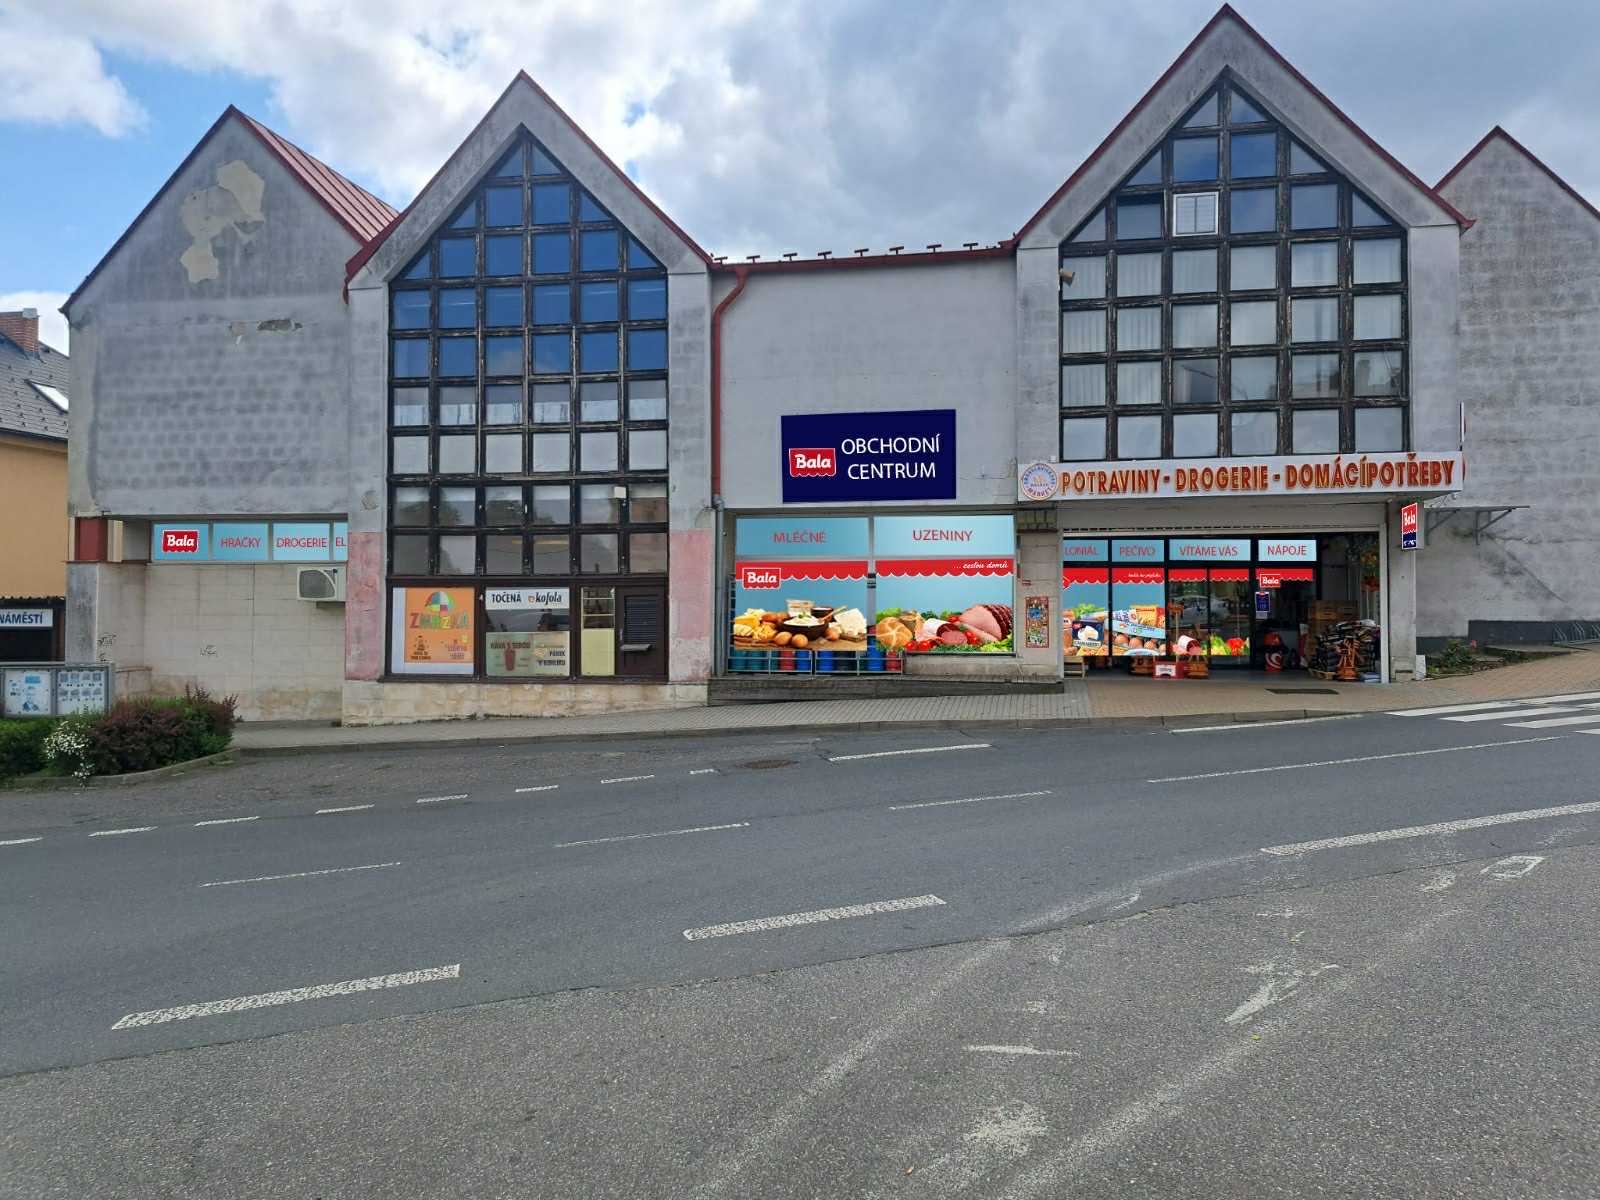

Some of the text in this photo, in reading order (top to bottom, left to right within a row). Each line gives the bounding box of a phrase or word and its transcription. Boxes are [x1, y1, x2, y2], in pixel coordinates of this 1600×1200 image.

[841, 433, 940, 455] OBCHODNÍ
[794, 453, 832, 469] Bala
[847, 462, 936, 480] CENTRUM
[1062, 468, 1161, 495] POTRAVINY
[1176, 465, 1268, 492] DROGERIE
[166, 534, 195, 547] Bala
[220, 535, 261, 548] HRAČKY
[773, 530, 826, 544] MLÉČNÉ
[912, 529, 973, 542] UZENINY
[276, 537, 327, 548] DROGERIE
[1179, 545, 1238, 556] VÍTÁME VÁS
[1267, 543, 1307, 556] NÁPOJE
[747, 571, 777, 584] Bala
[491, 591, 562, 605] TOČENÁ kofola
[0, 611, 43, 625] NÁMĚSTÍ
